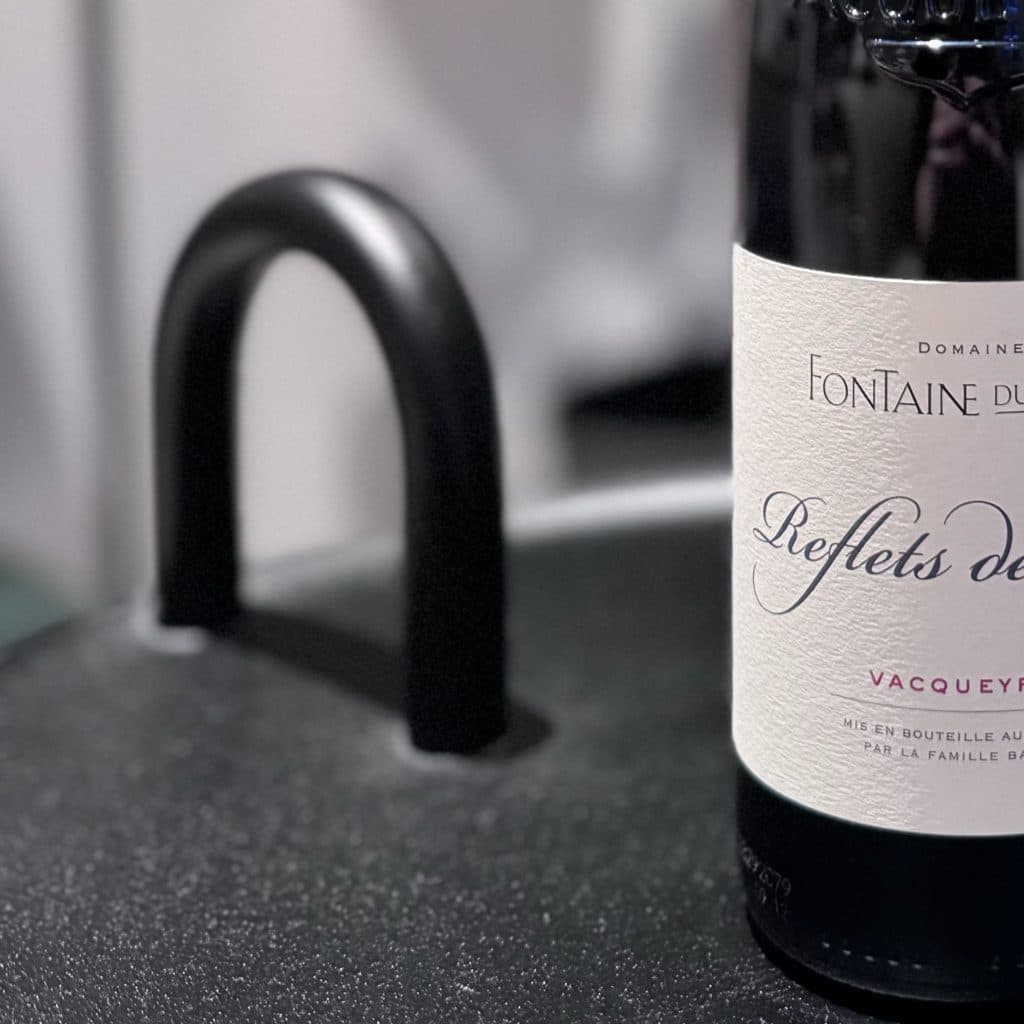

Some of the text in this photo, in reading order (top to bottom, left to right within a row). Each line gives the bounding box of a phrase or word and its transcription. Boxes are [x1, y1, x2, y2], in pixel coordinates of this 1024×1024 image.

[918, 341, 1024, 355] DOMAINE
[809, 353, 979, 416] FONTAINE
[752, 490, 953, 616] Reflets
[842, 717, 868, 732] MIS
[874, 724, 895, 737] EN
[902, 728, 995, 742] BOUTEILLE
[1001, 731, 1023, 742] AU
[863, 741, 892, 755] PAR
[901, 747, 920, 759] LA
[928, 749, 999, 762] FAMILLE
